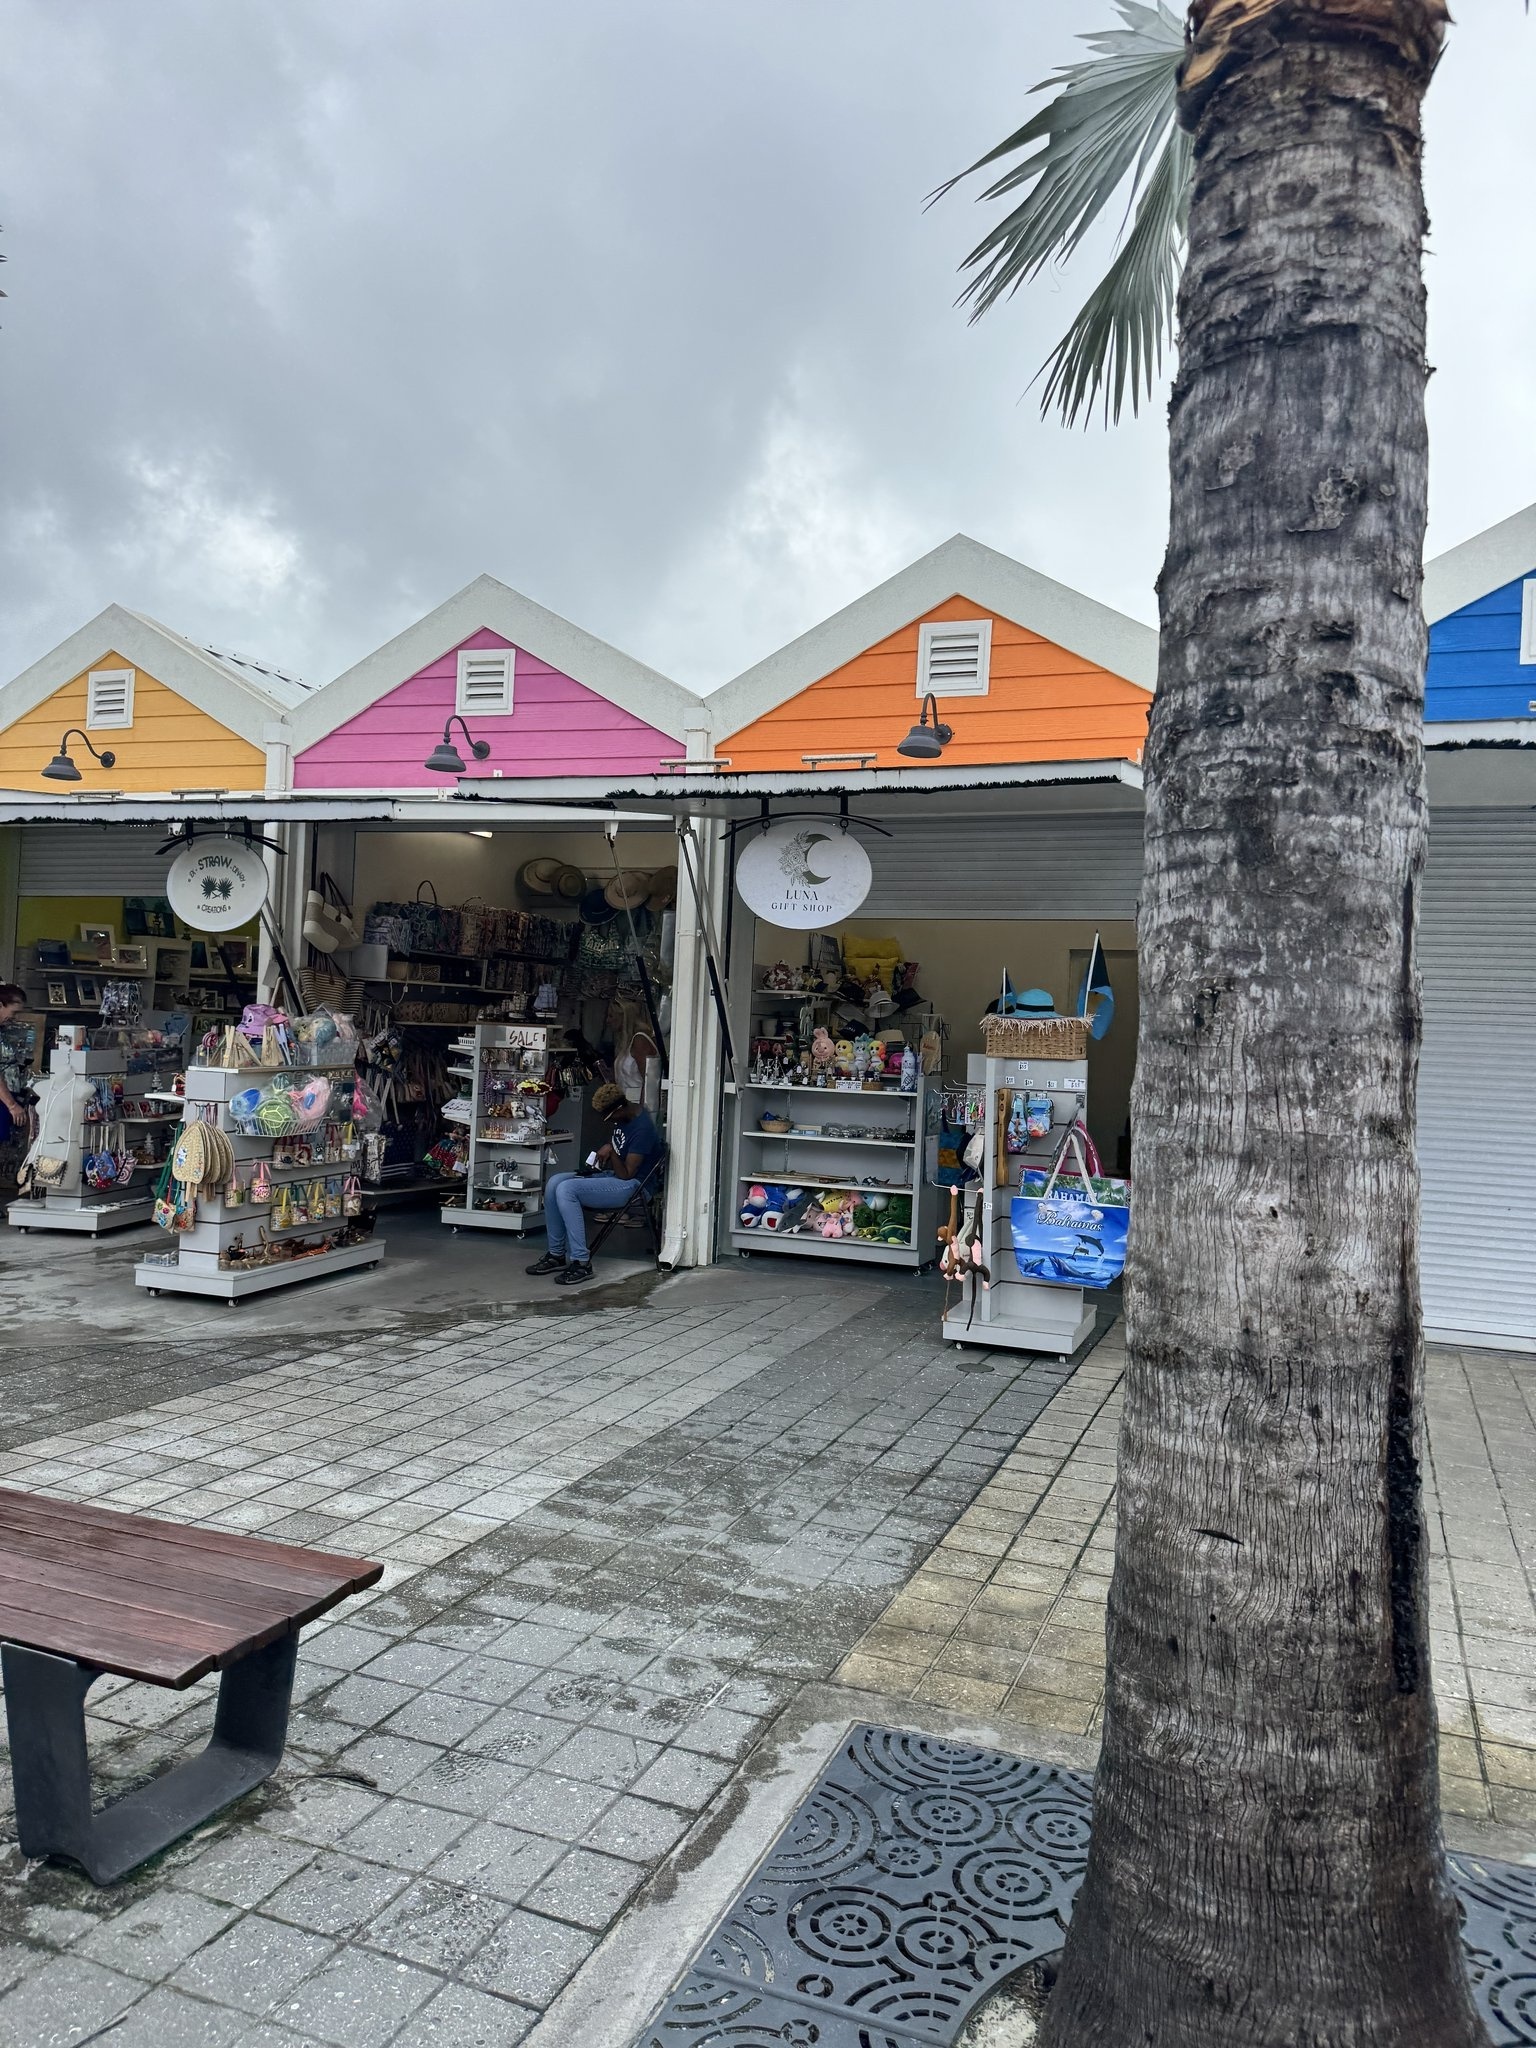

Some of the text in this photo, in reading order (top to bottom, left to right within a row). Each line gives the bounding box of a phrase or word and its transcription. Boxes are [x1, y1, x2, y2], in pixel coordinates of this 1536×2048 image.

[786, 889, 818, 901] LUNA
[771, 902, 832, 912] GIFT SHOP
[1036, 1209, 1104, 1231] Bahamas
